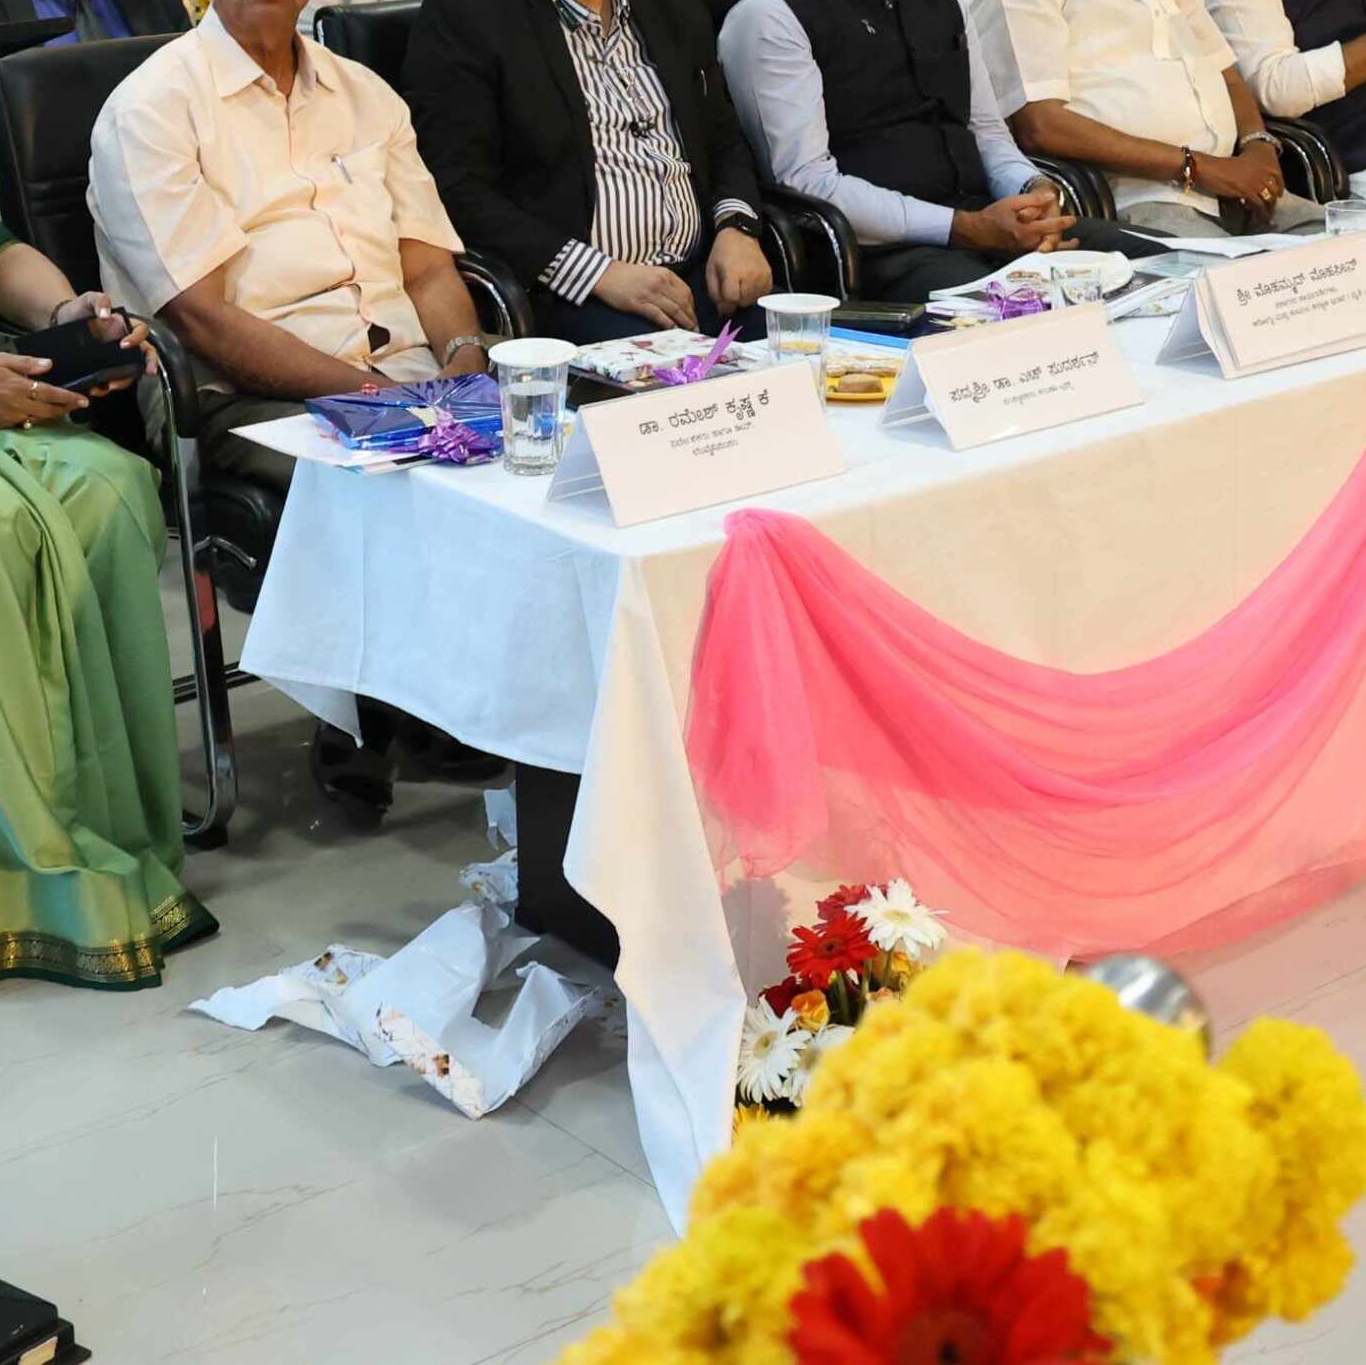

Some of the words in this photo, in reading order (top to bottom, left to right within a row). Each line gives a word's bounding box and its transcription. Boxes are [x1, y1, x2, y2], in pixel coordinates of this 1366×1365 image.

[668, 402, 719, 428] ರಮೇಶ್
[726, 394, 756, 421] ಕೃಷ್ಣ
[757, 388, 769, 405] ಕೆ
